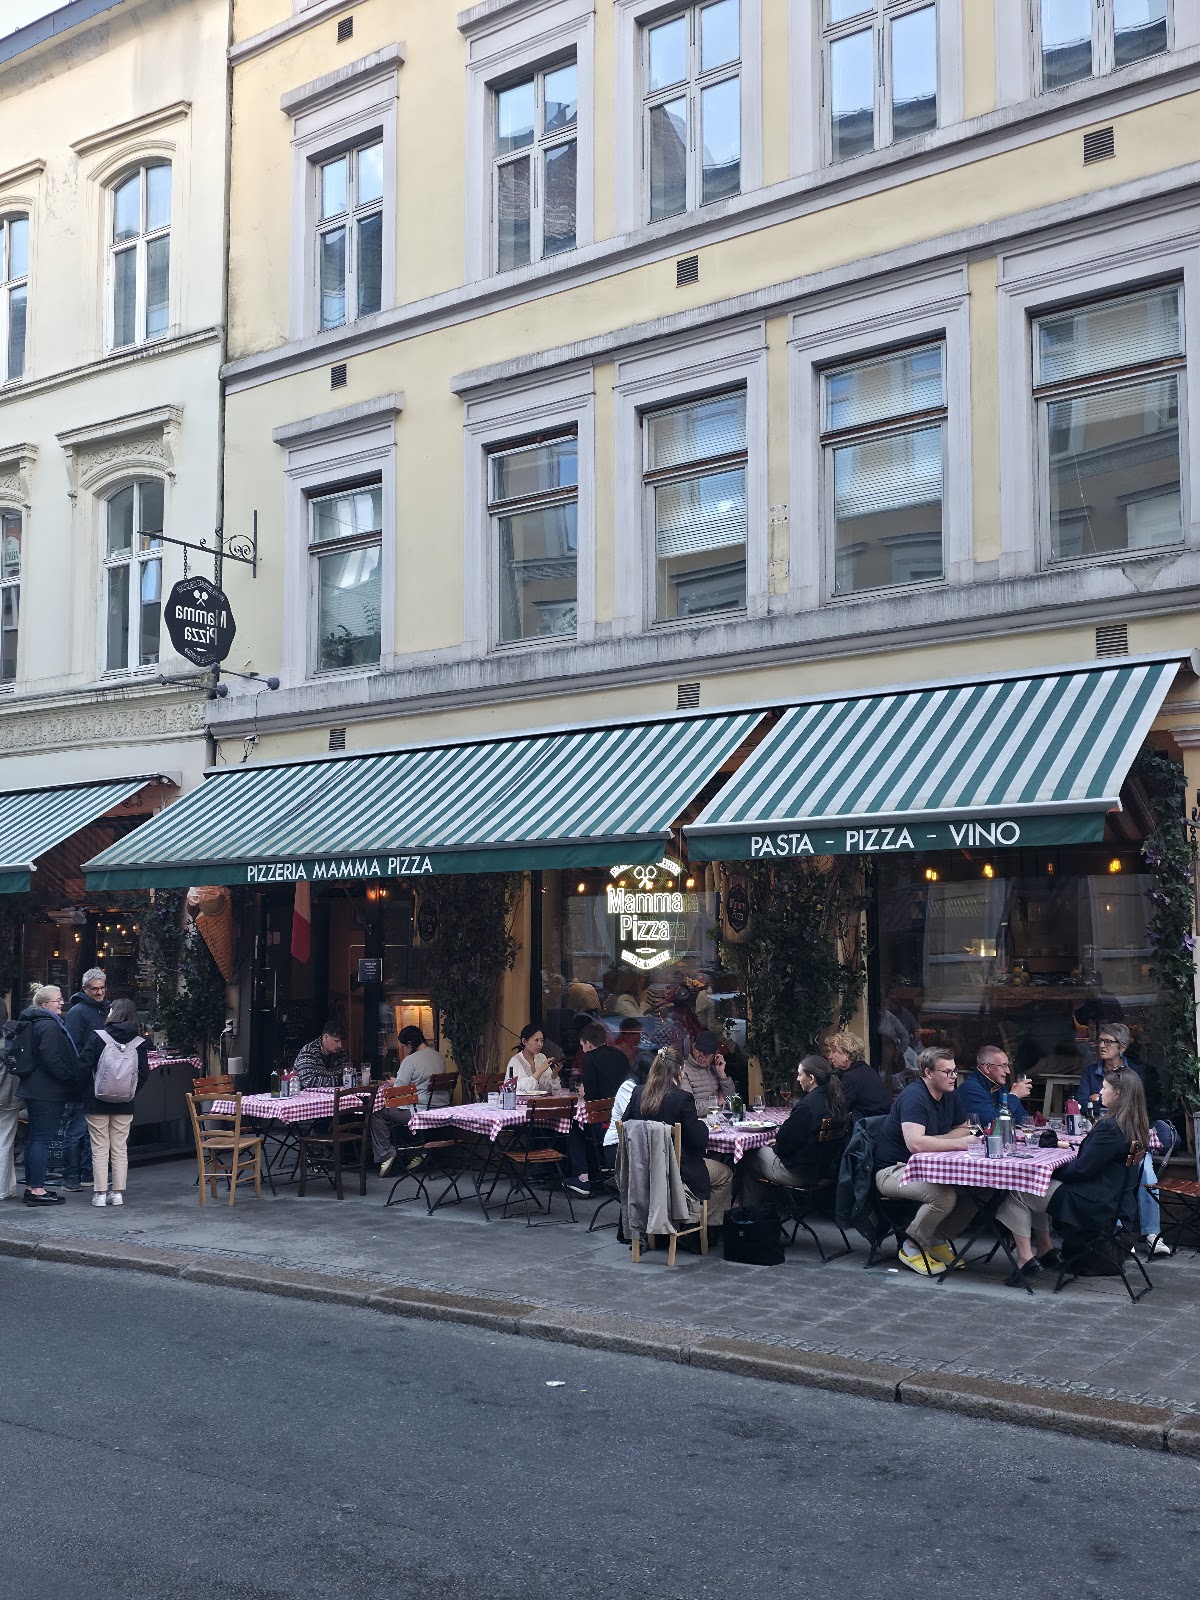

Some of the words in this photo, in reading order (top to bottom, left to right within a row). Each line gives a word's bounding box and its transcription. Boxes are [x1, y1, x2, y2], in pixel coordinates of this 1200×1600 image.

[751, 833, 815, 857] PASTA
[846, 827, 915, 852] PIZZA
[948, 821, 1021, 847] VINO
[247, 862, 308, 882] PIZZERIA
[312, 858, 382, 879] MAMMA
[387, 855, 433, 875] PIZZA
[607, 887, 684, 914] Mamma
[620, 914, 670, 941] Pizza
